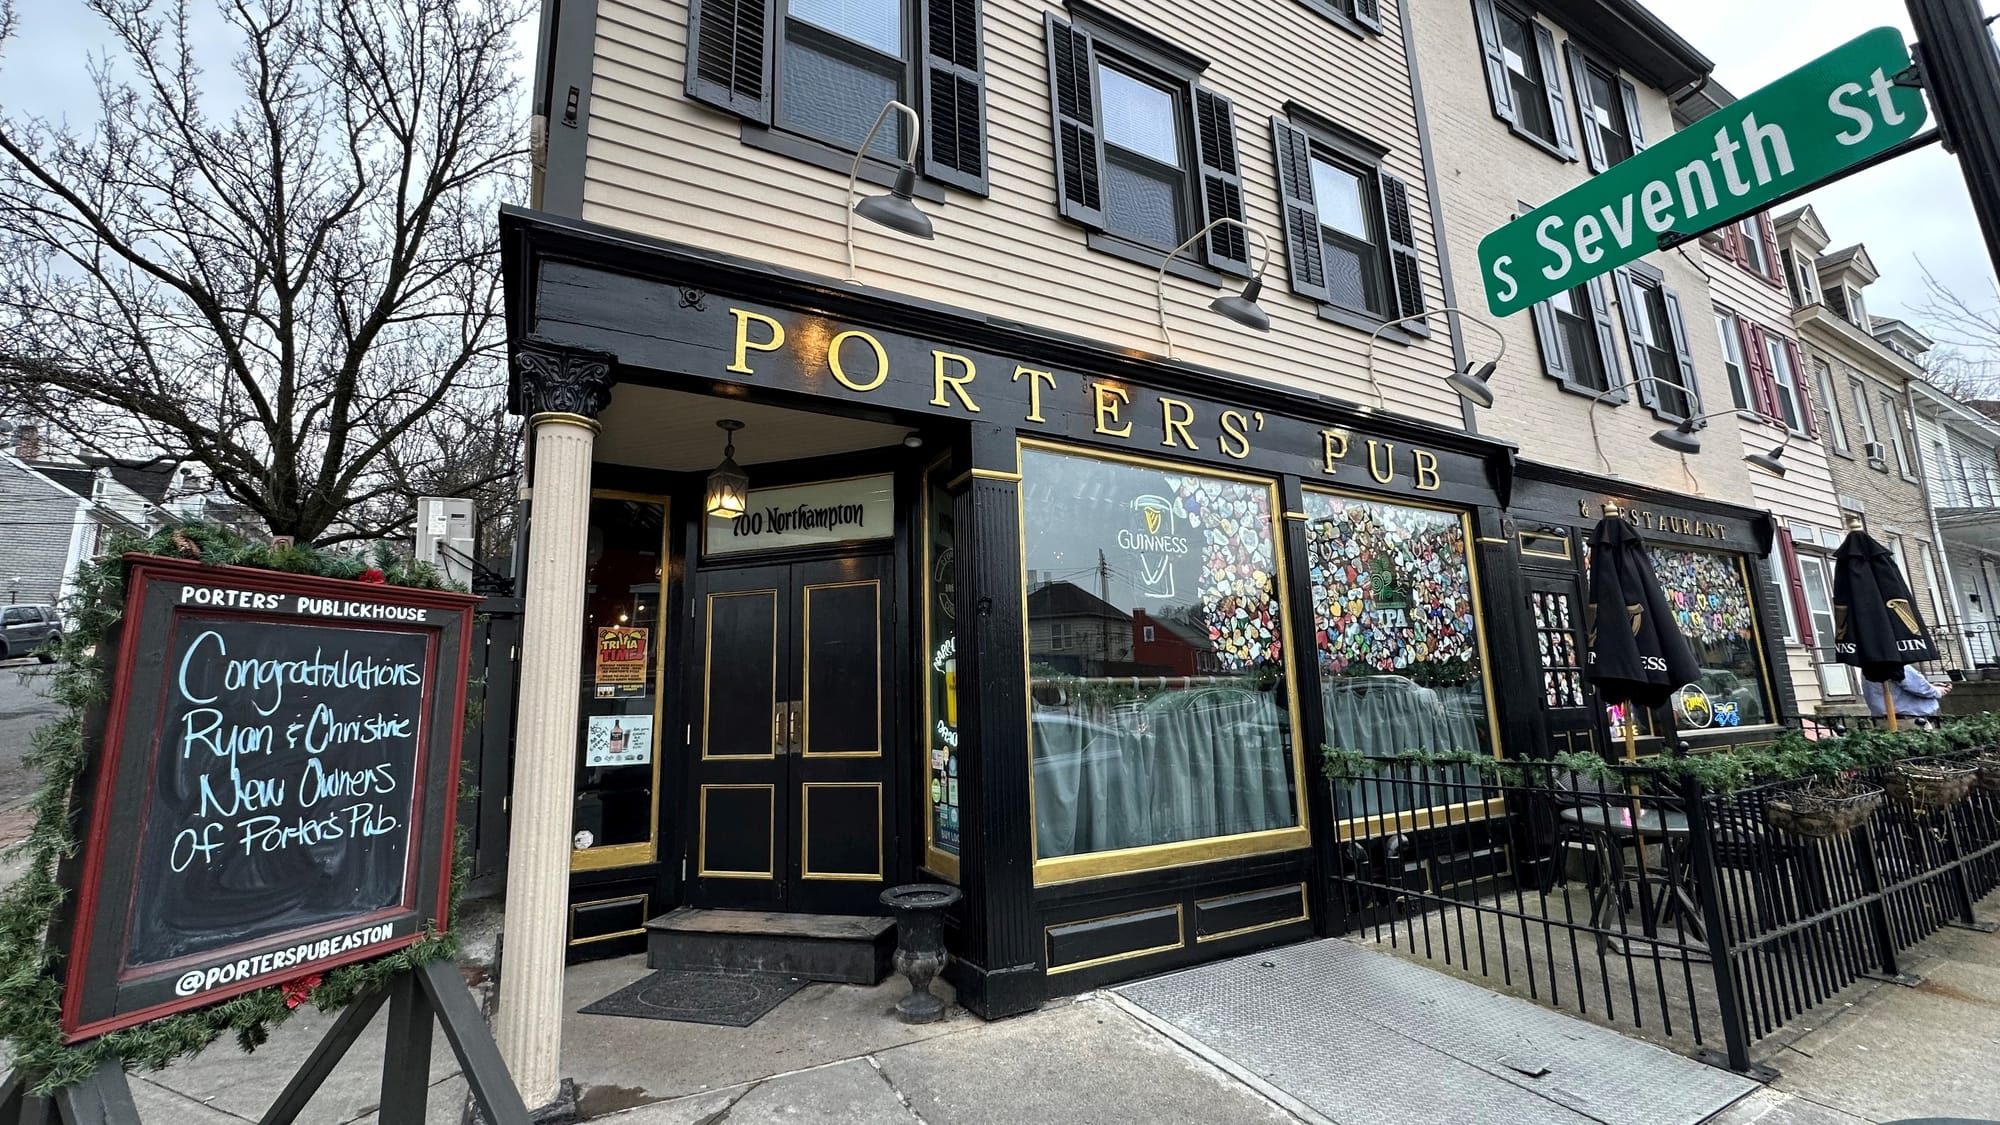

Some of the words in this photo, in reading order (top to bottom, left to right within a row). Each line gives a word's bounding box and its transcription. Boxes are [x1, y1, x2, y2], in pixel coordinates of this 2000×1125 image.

[1493, 255, 1518, 302] S
[1535, 112, 1795, 280] Seventh
[1828, 67, 1906, 146] St
[726, 307, 1264, 459] PORTERS'
[1321, 429, 1441, 491] PUB
[733, 513, 762, 536] 700
[766, 504, 864, 534] Northampton
[1117, 529, 1188, 554] GUINNESS
[1602, 505, 1726, 540] ESTAURANT
[181, 586, 286, 609] PORTERS'
[297, 596, 427, 622] PUBLICKHOUSE
[1377, 609, 1408, 627] IPA
[602, 633, 638, 650] TRIVIA
[178, 630, 421, 716] Congratulations
[182, 708, 273, 780] Ryan
[200, 767, 285, 818] New
[299, 757, 396, 807] Owners
[175, 922, 394, 996] @PORTERSPUBEASTON
